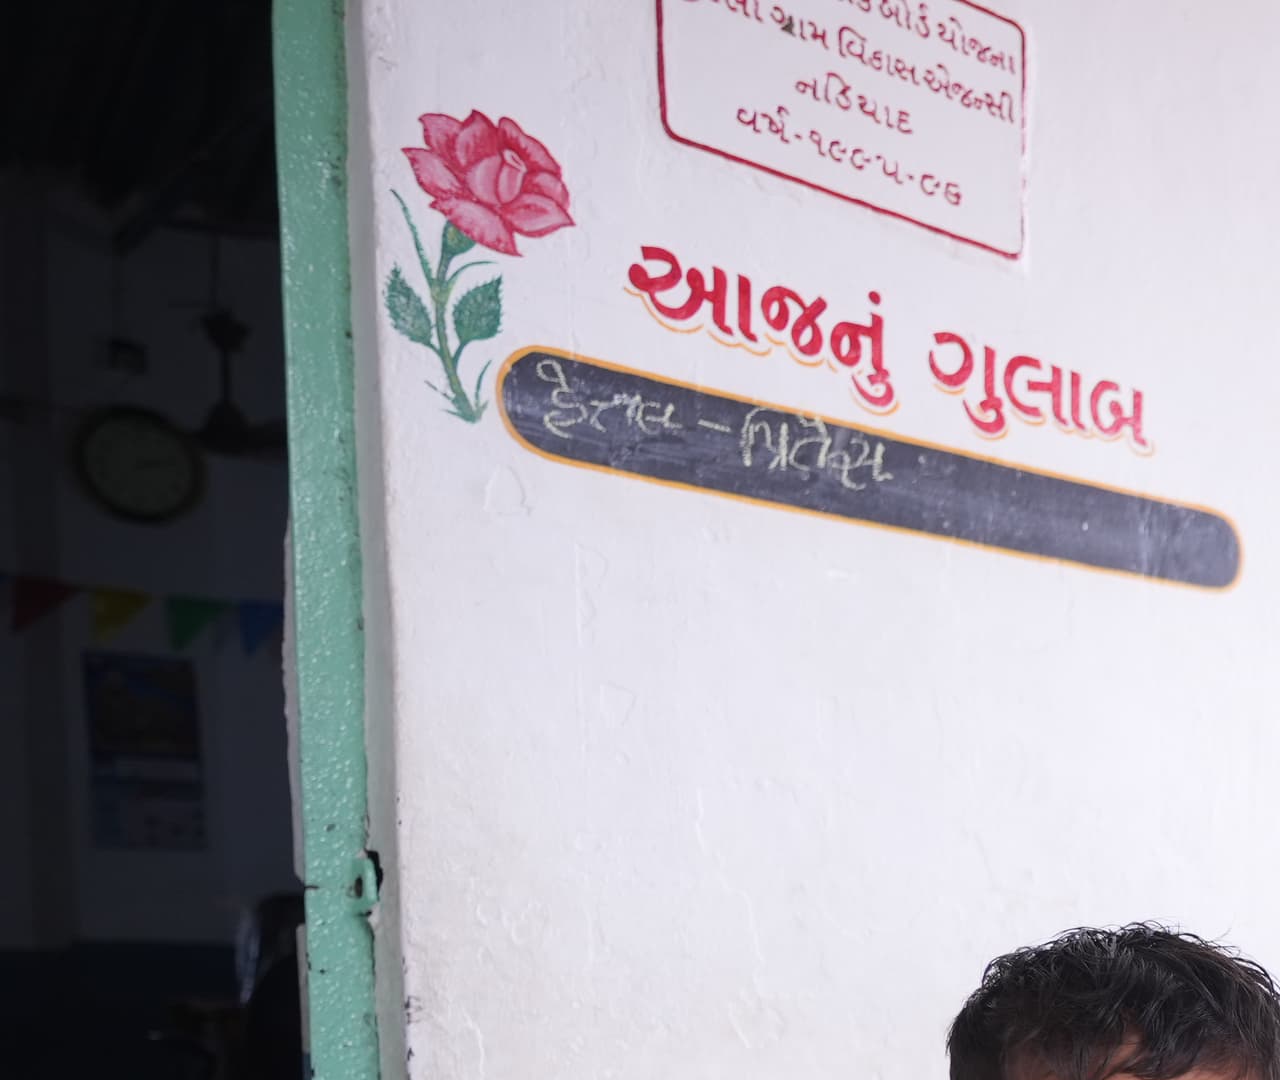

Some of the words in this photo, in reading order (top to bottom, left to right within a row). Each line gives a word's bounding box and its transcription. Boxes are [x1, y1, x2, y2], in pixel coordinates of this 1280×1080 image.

[839, 26, 920, 86] વિકાસ
[923, 63, 1015, 124] એજન્સી
[937, 16, 1016, 75] યોજના
[794, 72, 914, 135] નડિયાદ
[627, 245, 893, 405] આજનું
[928, 331, 1147, 446] ગુલાબ
